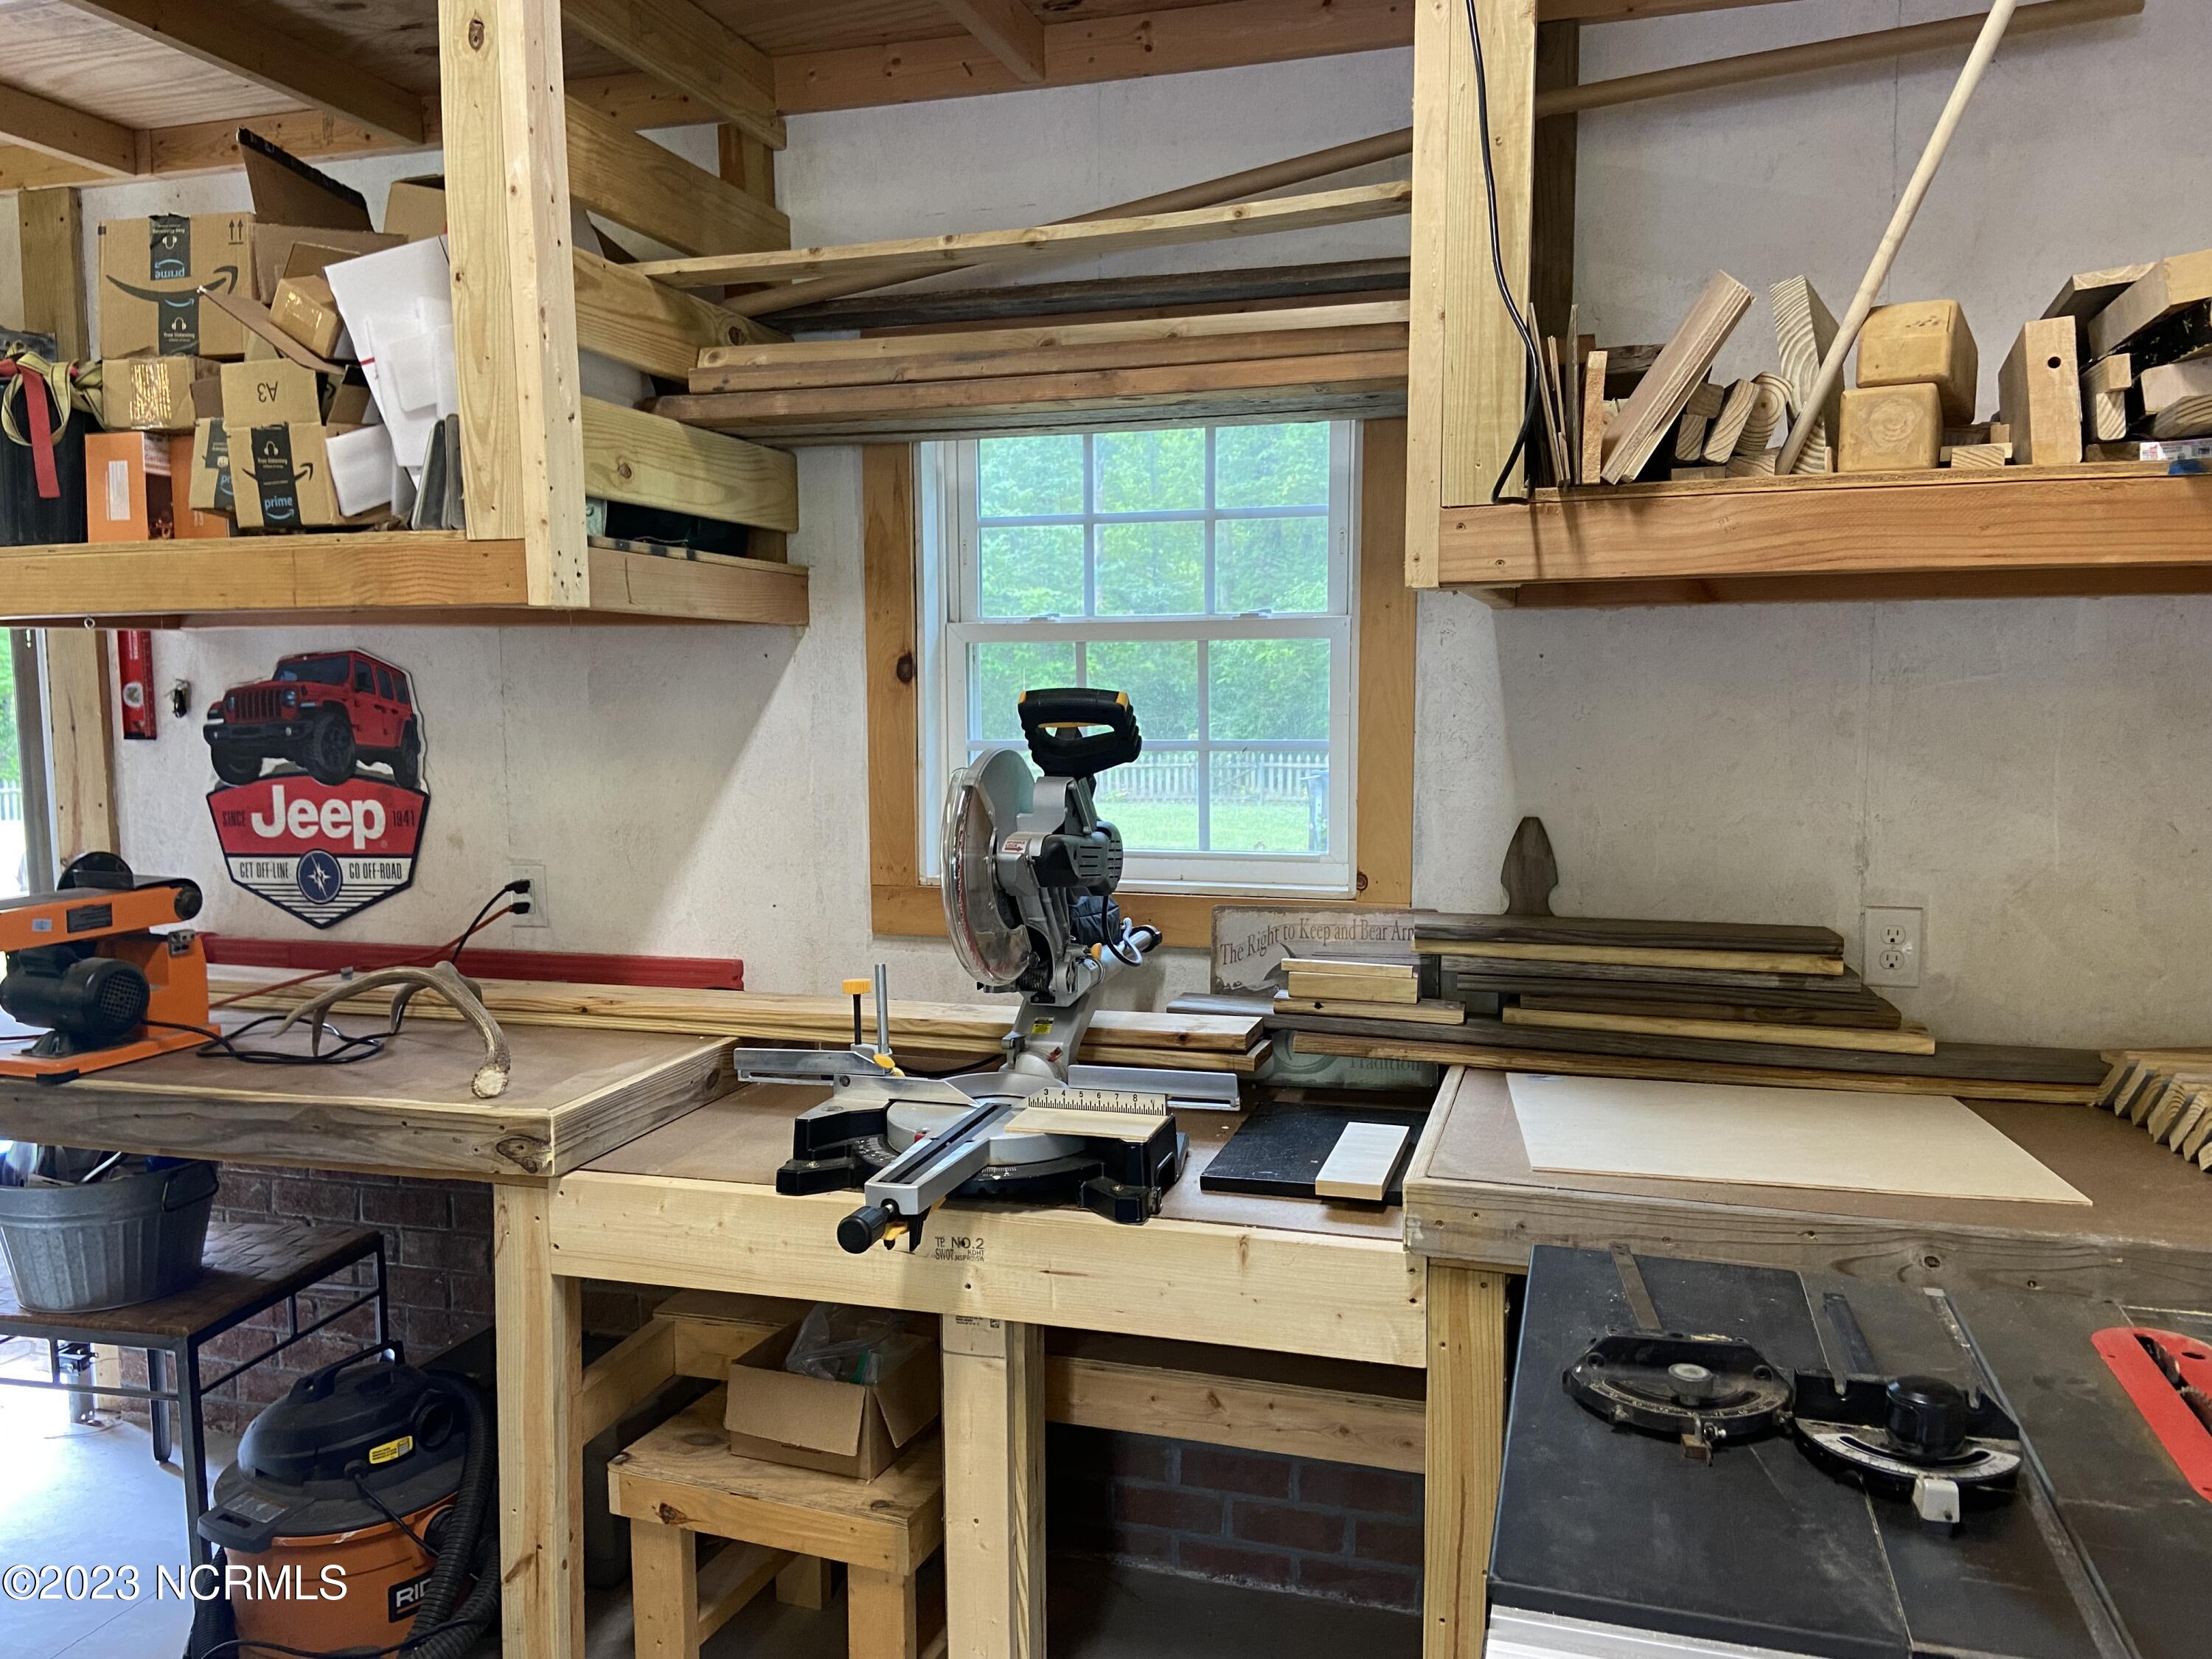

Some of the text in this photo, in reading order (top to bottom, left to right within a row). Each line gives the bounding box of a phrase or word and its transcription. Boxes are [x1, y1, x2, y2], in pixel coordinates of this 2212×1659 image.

[264, 495, 293, 510] prime
[223, 784, 414, 850] SINCE Jeep 1941
[240, 862, 289, 879] GET OFF-LINE
[349, 861, 403, 880] GO OFF-ROAD
[1220, 943, 1245, 966] The
[1247, 925, 1279, 957] Right
[1283, 924, 1295, 940] to
[1299, 917, 1329, 946] Keep
[1334, 919, 1356, 940] and
[1360, 919, 1388, 941] Bear
[951, 1237, 984, 1249] NO.2
